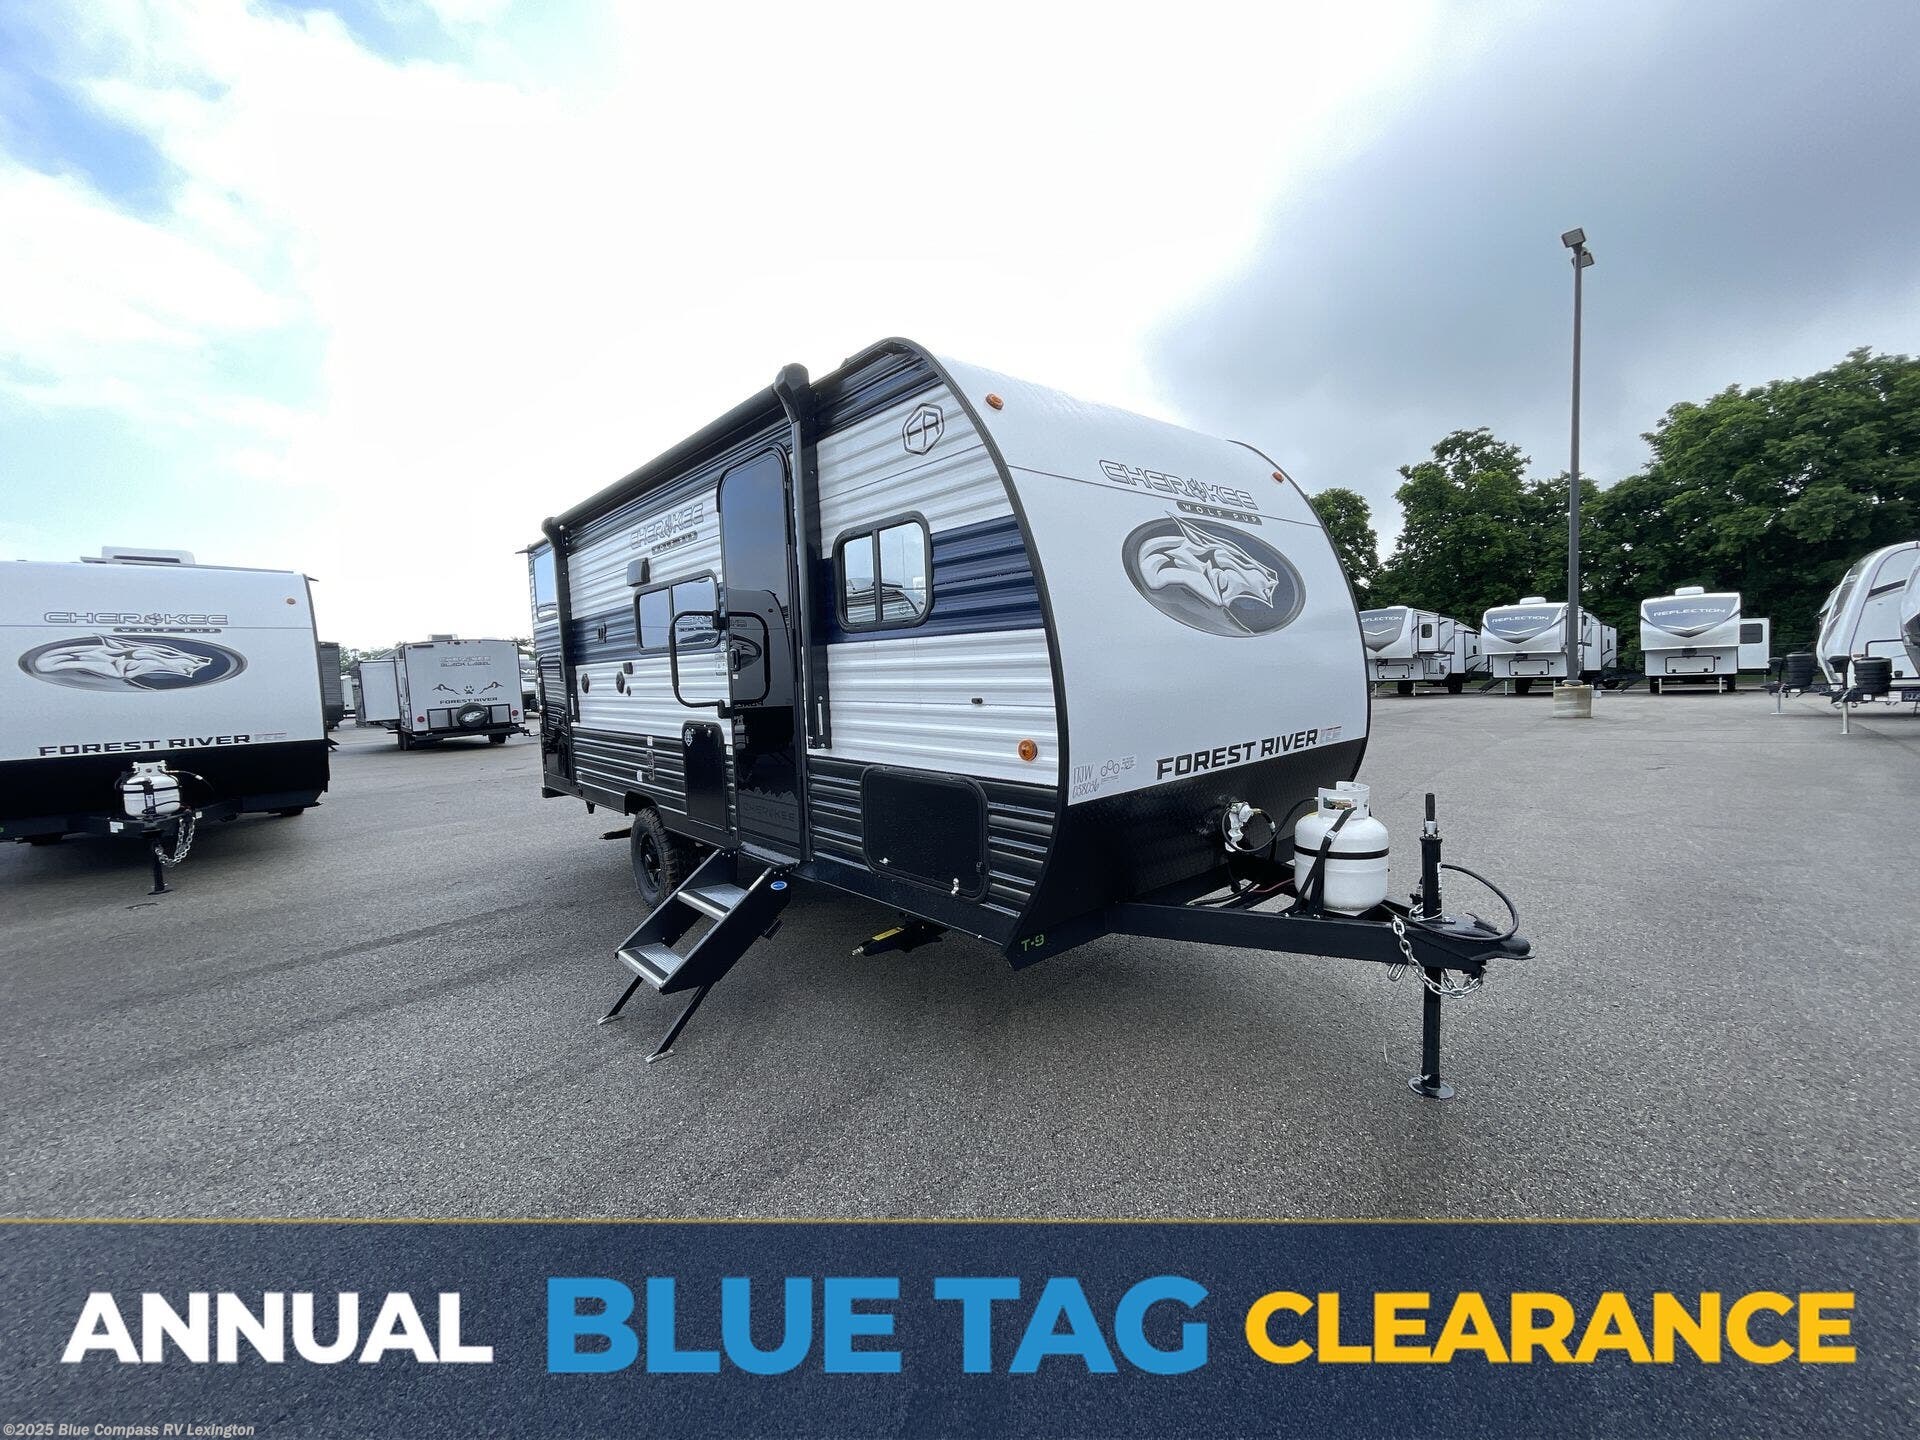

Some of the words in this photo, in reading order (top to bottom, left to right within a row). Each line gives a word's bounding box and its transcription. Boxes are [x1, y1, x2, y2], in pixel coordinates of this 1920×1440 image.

[1182, 503, 1223, 517] WOLF
[1231, 512, 1258, 523] PUP
[1492, 615, 1549, 623] REFLECTION
[1653, 608, 1726, 617] REFLECTION
[39, 740, 161, 757] FOREST
[169, 735, 251, 749] RIVER
[1156, 740, 1257, 781] FOREST
[1260, 728, 1319, 757] RIVER
